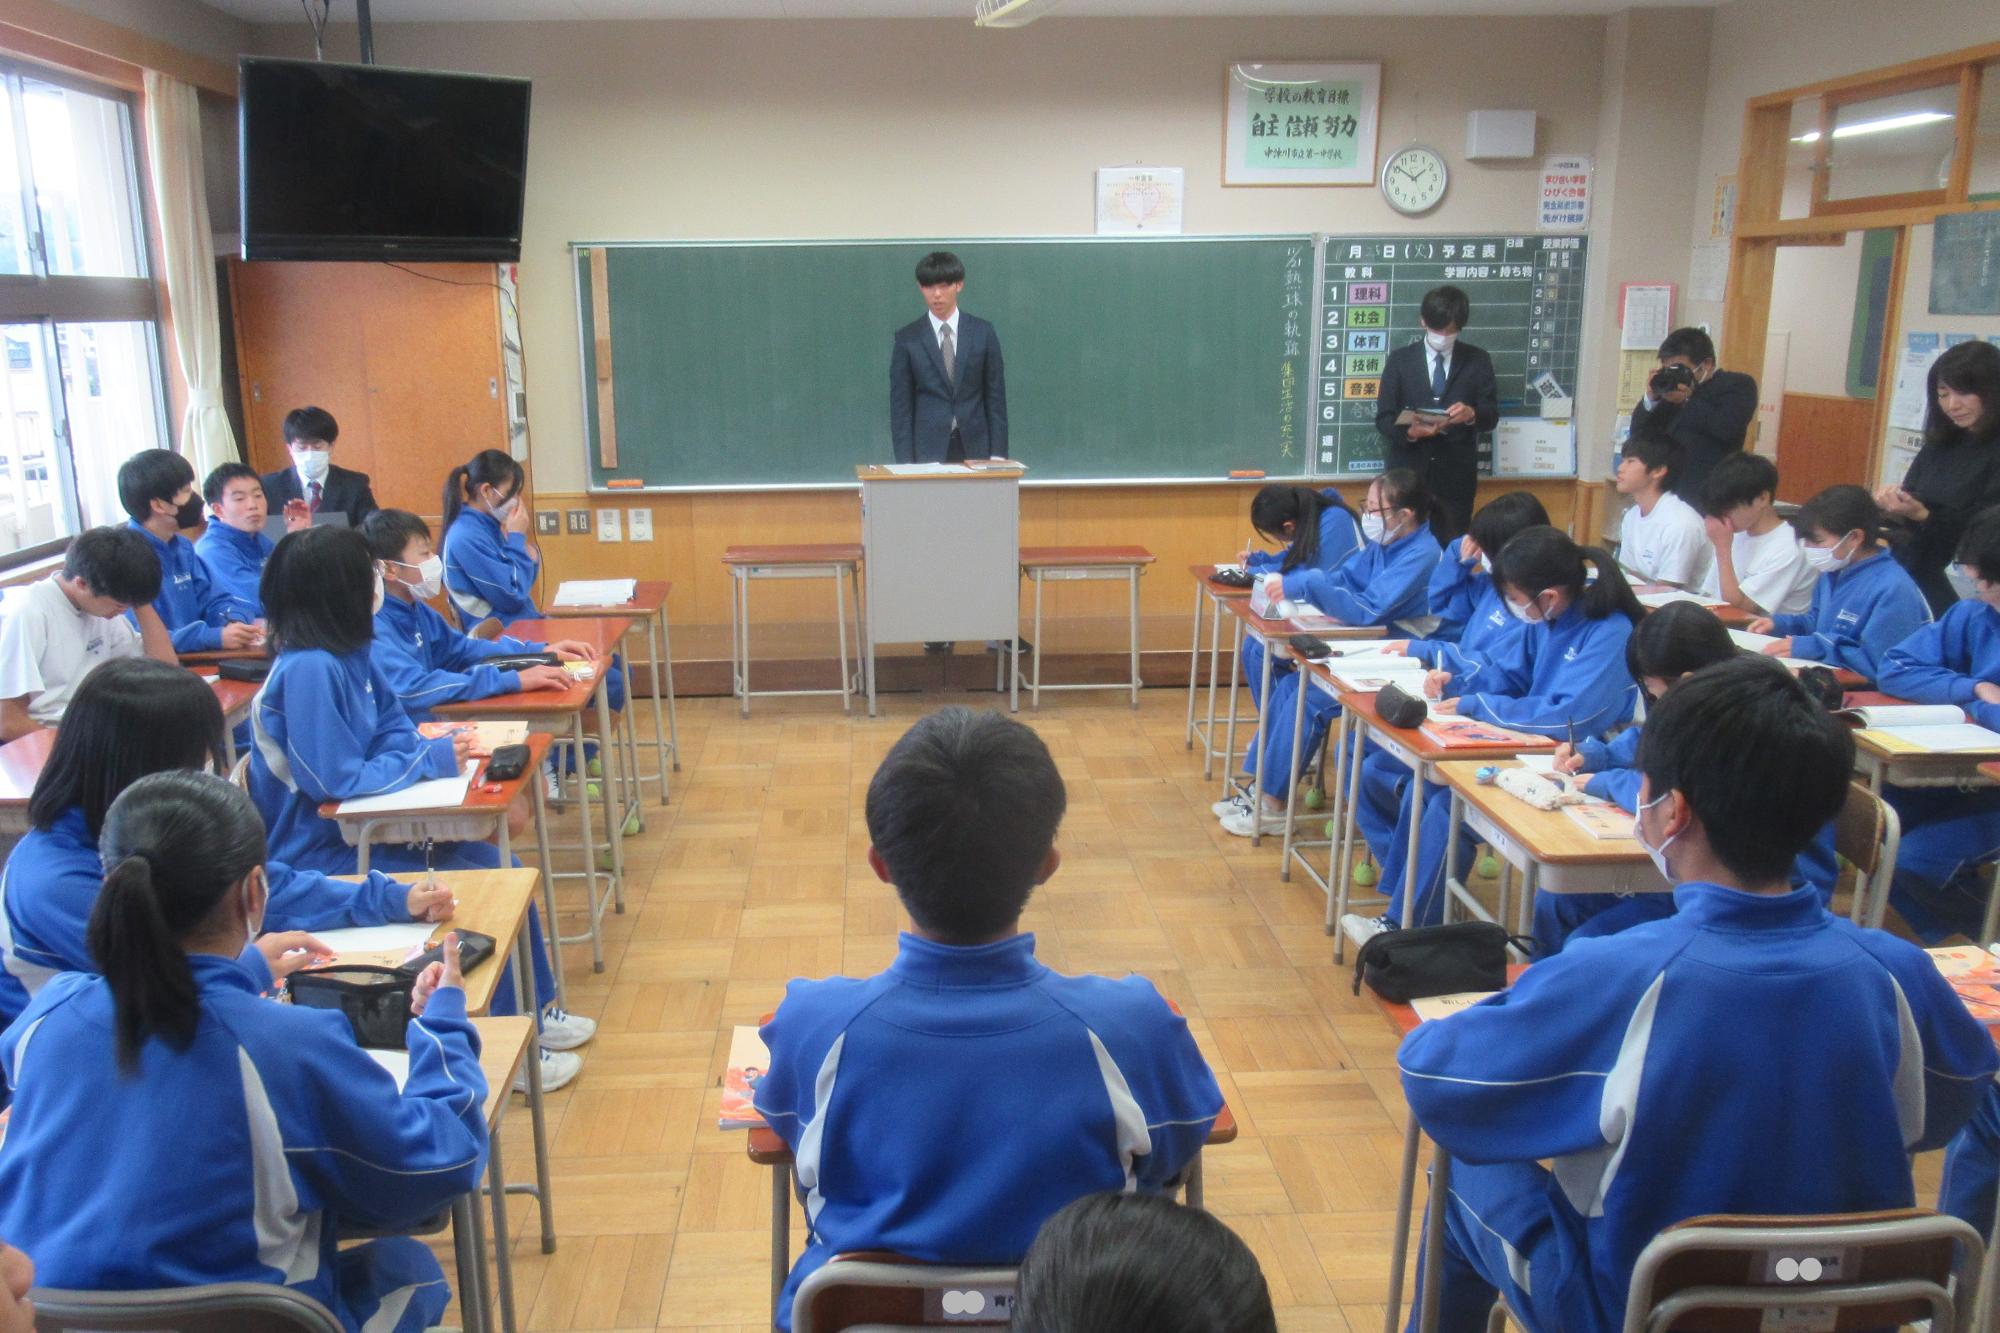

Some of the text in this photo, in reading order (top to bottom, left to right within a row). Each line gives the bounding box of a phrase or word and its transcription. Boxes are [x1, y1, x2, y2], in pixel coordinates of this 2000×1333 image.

[1264, 86, 1350, 105] 学校の教育目標
[1252, 112, 1357, 138] 自主 信頼 努力
[1264, 146, 1343, 160] 中津川市立第一中学校
[1410, 153, 1417, 163] 12
[1428, 162, 1434, 172] 2
[1389, 176, 1395, 185] 9
[1432, 173, 1438, 182] 3
[1394, 186, 1400, 196] 8
[1428, 184, 1434, 193] 4
[1402, 191, 1407, 202] 7
[1411, 195, 1416, 205] 6
[1421, 191, 1427, 201] 5
[1344, 266, 1373, 279] 教科
[1538, 272, 1542, 281] 1
[1331, 286, 1337, 301] 1
[1354, 287, 1381, 301] 理科
[1535, 289, 1543, 298] 2
[1534, 306, 1541, 315] 3
[1327, 311, 1339, 325] 2
[1354, 311, 1380, 325] 社会
[1532, 322, 1540, 331] 4
[1326, 335, 1338, 349] 3
[1354, 335, 1380, 349] 体育
[1531, 340, 1539, 348] 5
[1324, 359, 1337, 373] 4
[1352, 359, 1379, 373] 技術
[1530, 356, 1538, 365] 6
[1324, 383, 1336, 396] 5
[1350, 382, 1376, 396] 音楽
[1323, 406, 1335, 419] 6
